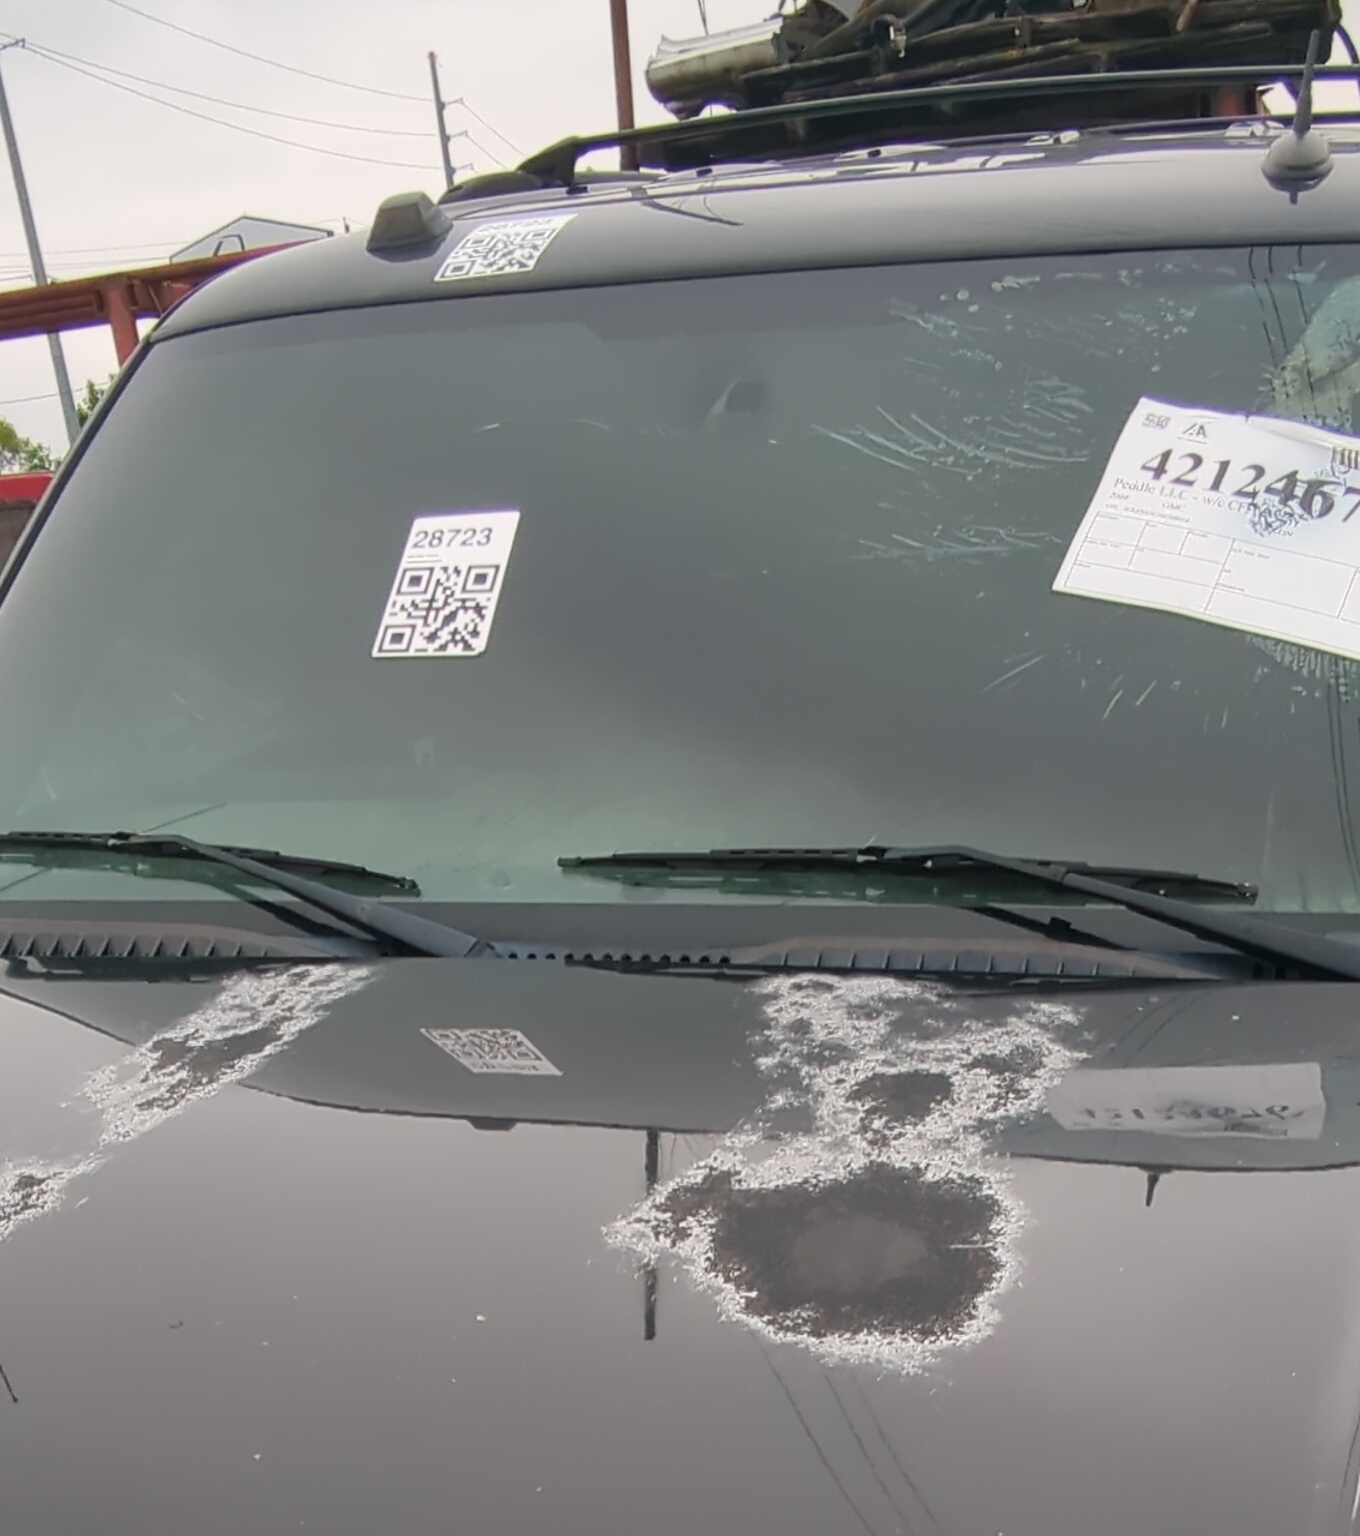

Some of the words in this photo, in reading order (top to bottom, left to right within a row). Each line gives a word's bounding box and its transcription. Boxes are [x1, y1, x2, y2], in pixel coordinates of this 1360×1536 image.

[1113, 477, 1157, 495] Peddle
[1159, 486, 1191, 501] LLC
[411, 527, 493, 549] 28723
